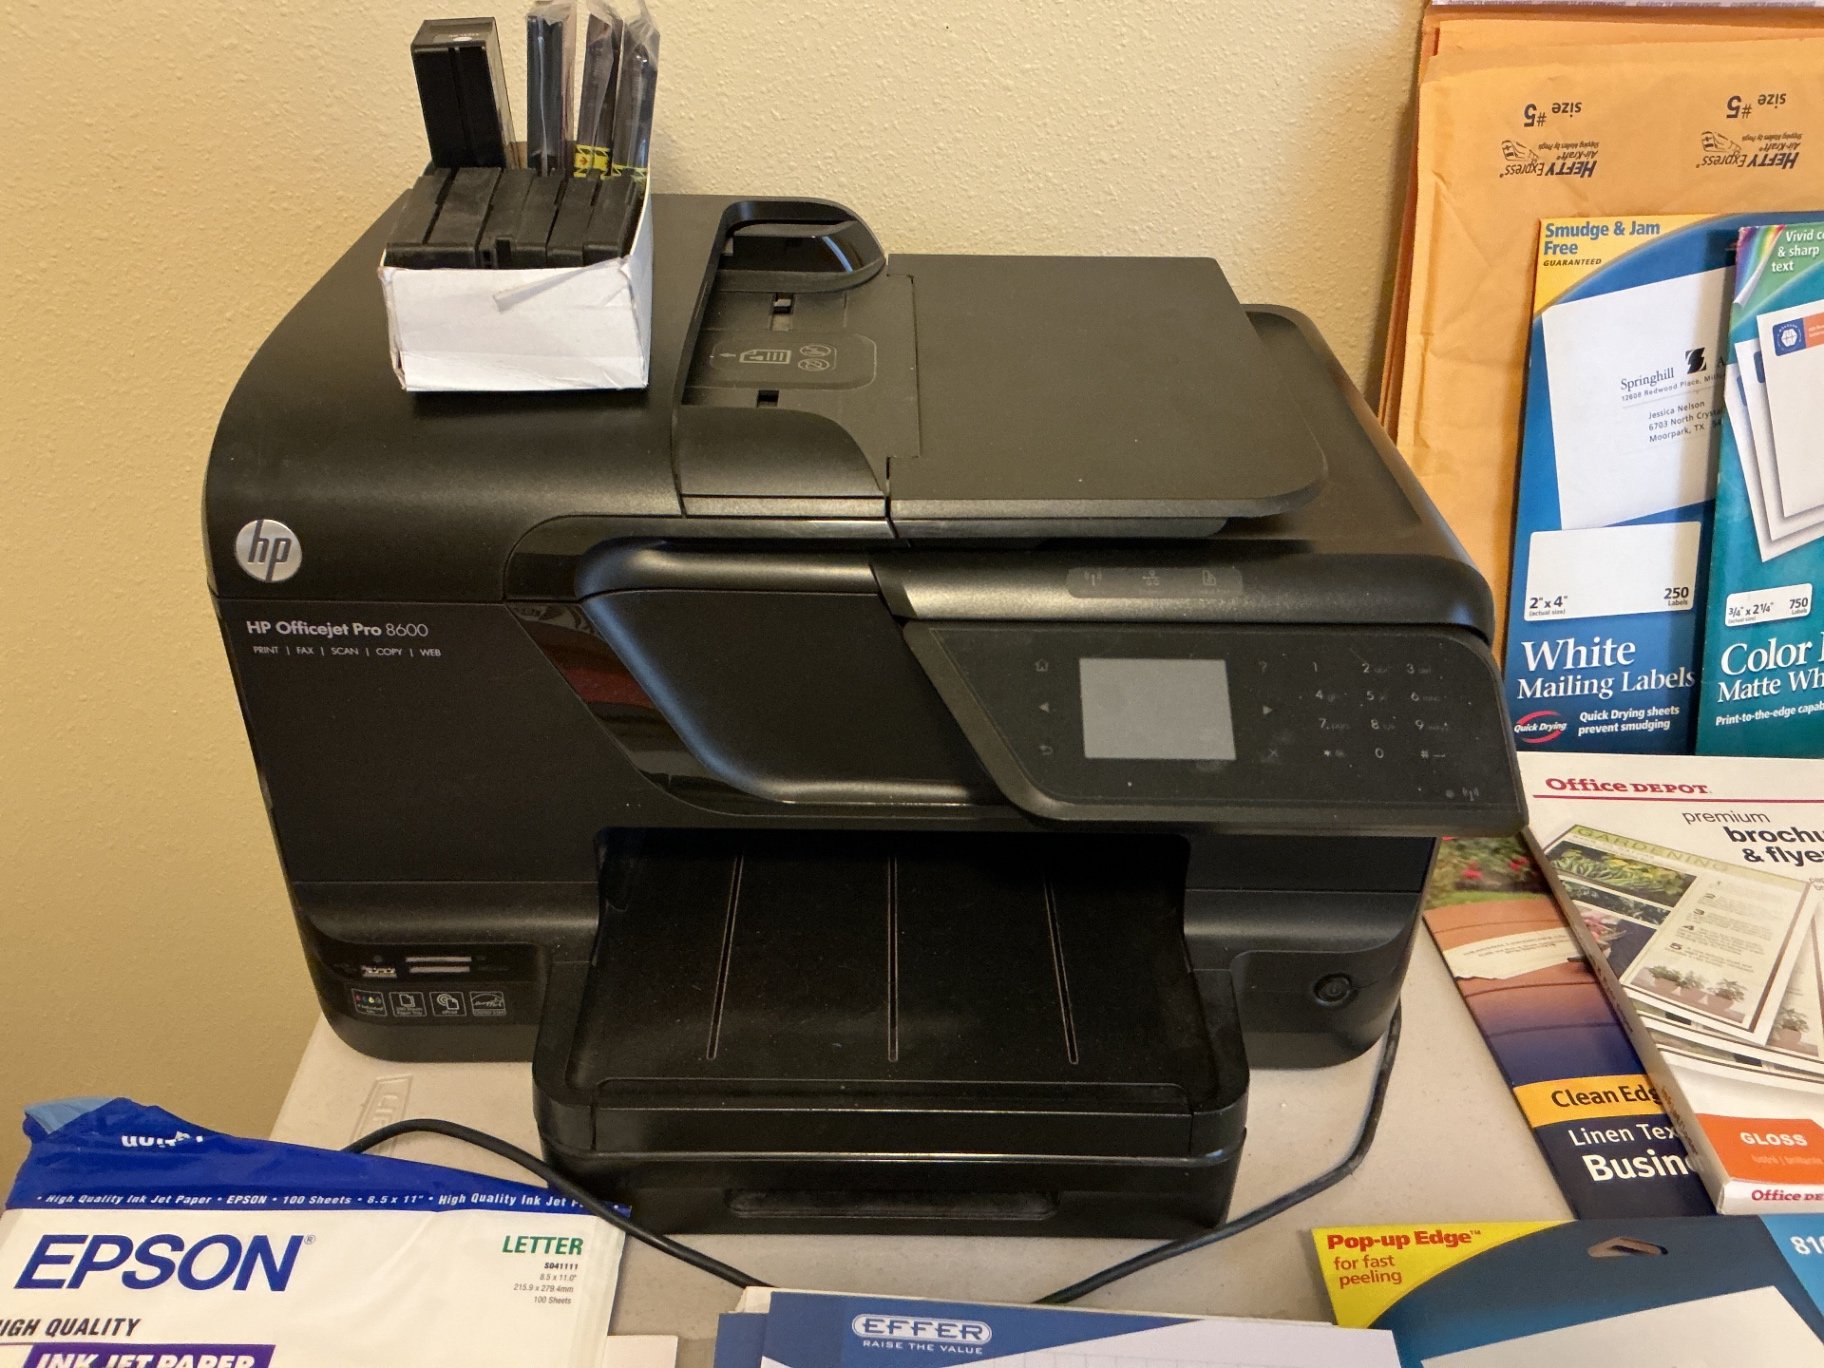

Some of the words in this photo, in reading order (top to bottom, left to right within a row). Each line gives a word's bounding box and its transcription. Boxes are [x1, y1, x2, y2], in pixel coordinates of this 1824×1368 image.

[1551, 101, 1582, 118] size
[1726, 95, 1752, 119] #5
[1757, 93, 1787, 109] size
[1524, 103, 1547, 127] #5
[1545, 160, 1597, 178] HEFTY
[1747, 152, 1799, 169] HEFTY
[1545, 221, 1609, 241] Smudge
[1613, 221, 1625, 236] &
[1629, 221, 1660, 235] Jam
[1785, 230, 1814, 243] Vivid
[1816, 231, 1824, 240] c
[1543, 241, 1578, 256] Free
[1777, 247, 1786, 258] &
[1789, 245, 1820, 258] sharp
[1543, 258, 1602, 267] GUARANTEED
[1771, 260, 1794, 272] text
[1620, 367, 1675, 392] Springhill
[1644, 383, 1678, 396] Redwood
[1648, 408, 1675, 420] Jessica
[1677, 401, 1705, 412] Nelson
[1649, 420, 1668, 431] 6703
[1670, 414, 1694, 426] North
[1649, 427, 1692, 443] Moorpark,
[1694, 423, 1705, 431] TX
[1663, 586, 1689, 600] 250
[1529, 597, 1543, 609] 2"
[1544, 600, 1551, 608] x
[1553, 595, 1568, 607] 4"
[1668, 599, 1688, 607] Labels
[1789, 597, 1809, 610] 750
[1745, 608, 1751, 616] x
[246, 620, 272, 634] HP
[275, 620, 350, 639] Officejet
[352, 622, 382, 636] Pro
[385, 623, 429, 637] 8600
[253, 646, 279, 655] PRINT
[296, 646, 315, 655] FAX
[330, 647, 359, 656] SCAN
[375, 647, 403, 656] COPY
[419, 648, 442, 657] WEB
[1521, 636, 1636, 672] White
[1721, 637, 1813, 676] Color
[1361, 662, 1370, 673] 2
[1406, 663, 1415, 674] 3
[1517, 674, 1615, 700] Mailing
[1621, 667, 1696, 692] Labels
[1717, 677, 1781, 703] Matte
[1315, 689, 1323, 699] 4
[1366, 690, 1375, 701] 5
[1410, 691, 1420, 702] 6
[1579, 710, 1610, 722] Quick
[1611, 707, 1645, 722] Drying
[1646, 705, 1680, 717] sheets
[1715, 706, 1797, 727] Print-to-the-edge
[1318, 717, 1327, 729] 7
[1370, 718, 1380, 730] 8
[1414, 719, 1424, 730] 9
[1514, 723, 1538, 734] Quick
[1539, 721, 1568, 732] Drying
[1578, 722, 1619, 737] prevent
[1621, 718, 1670, 731] smudging
[1545, 777, 1627, 792] Office
[1630, 783, 1709, 794] DEPOT
[1682, 810, 1771, 825] premium
[1577, 827, 1729, 872] GARDENING
[1742, 848, 1765, 863] &
[1551, 1087, 1619, 1108] Clean
[1568, 1126, 1634, 1147] Linen
[1739, 1131, 1808, 1147] GLOSS
[1582, 1149, 1691, 1182] Busin
[45, 1194, 74, 1204] High
[78, 1194, 123, 1205] Quality
[127, 1194, 146, 1204] Ink
[150, 1195, 171, 1204] Jet
[175, 1195, 212, 1205] Paper
[226, 1195, 267, 1205] EPSON
[282, 1195, 305, 1205] 100
[309, 1195, 352, 1205] Sheets
[367, 1195, 388, 1205] 8.5
[438, 1193, 467, 1206] High
[470, 1193, 517, 1207] Quality
[520, 1194, 542, 1206] Ink
[545, 1195, 567, 1207] Jet
[1751, 1189, 1802, 1202] Office
[501, 1235, 584, 1256] LETTER
[1327, 1233, 1411, 1252] Pop-up
[1790, 1235, 1824, 1255] 81
[1333, 1256, 1358, 1271] for
[1362, 1254, 1395, 1269] fast
[539, 1273, 551, 1281] 8.5
[1338, 1270, 1403, 1290] peeling
[513, 1283, 534, 1292] 215.9
[533, 1295, 547, 1304] 100
[548, 1296, 572, 1305] Sheets
[44, 1318, 141, 1337] QUALITY
[862, 1317, 984, 1341] EFFER
[862, 1339, 904, 1350] RAISE
[908, 1342, 935, 1352] THE
[939, 1345, 984, 1355] VALUE
